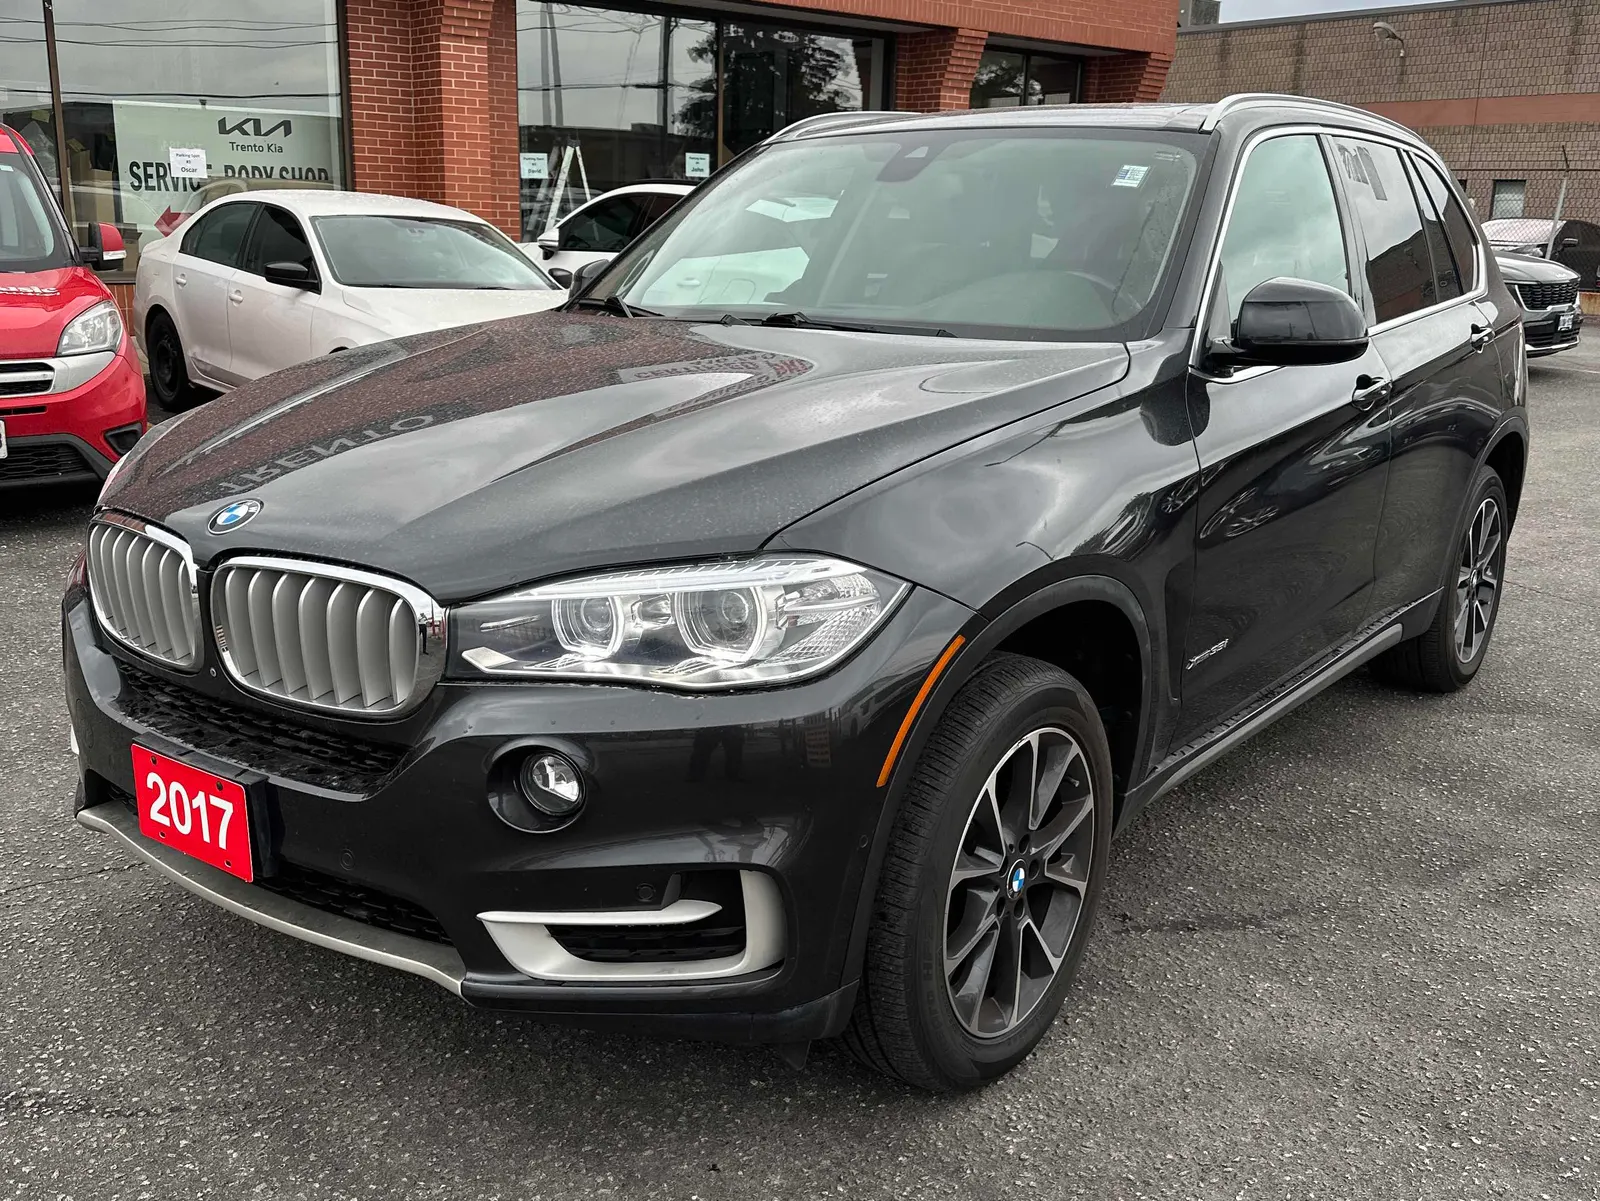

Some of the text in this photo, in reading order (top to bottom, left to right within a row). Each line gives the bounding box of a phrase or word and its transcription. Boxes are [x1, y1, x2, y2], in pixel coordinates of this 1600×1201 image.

[218, 117, 292, 138] KIA
[229, 141, 283, 153] Trento Kia
[129, 161, 212, 192] SERVIC
[146, 771, 234, 850] 2017
